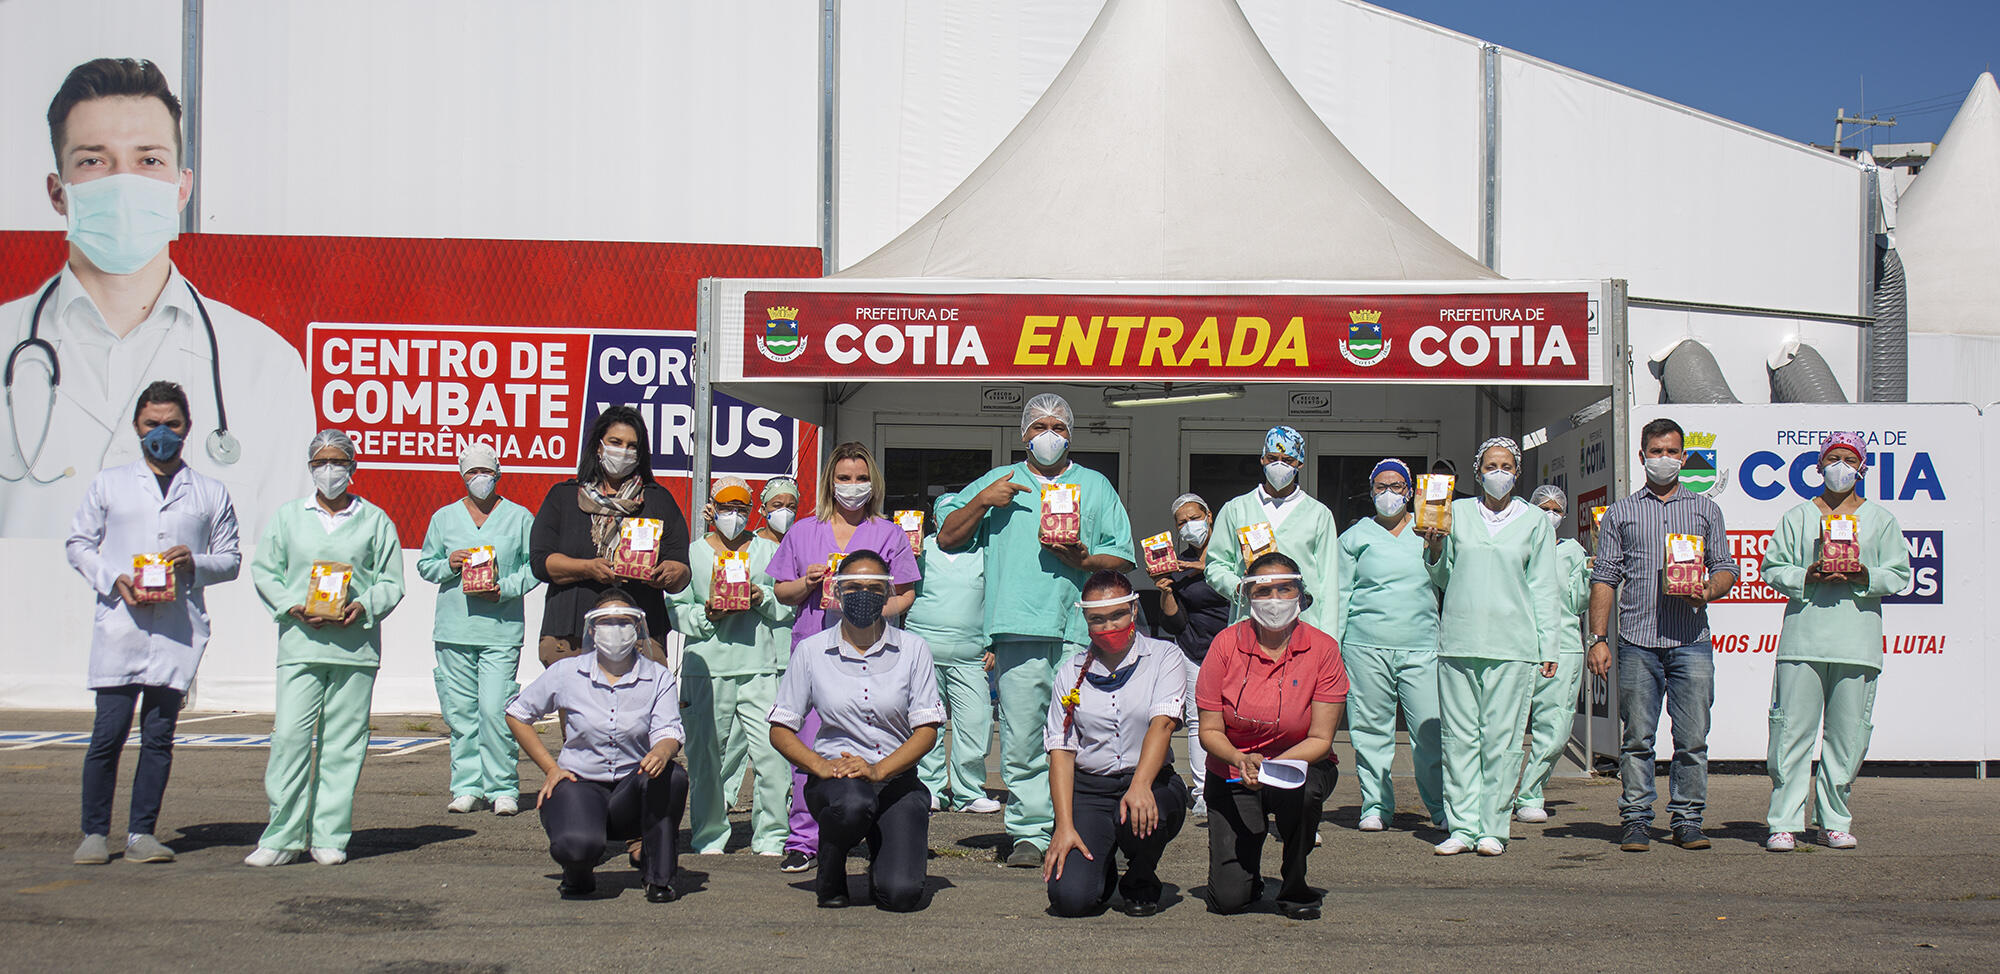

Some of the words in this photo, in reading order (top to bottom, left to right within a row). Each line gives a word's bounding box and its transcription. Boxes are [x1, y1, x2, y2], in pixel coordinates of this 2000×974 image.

[855, 308, 937, 321] PREFEITURA
[939, 308, 959, 321] DE
[1440, 308, 1522, 322] PREFEITURA
[1525, 308, 1545, 321] DE
[824, 323, 990, 365] COTIA
[1013, 315, 1310, 367] ENTRADA
[1408, 325, 1577, 367] COTIA
[322, 337, 498, 378] CENTRO
[510, 341, 567, 380] DE
[599, 347, 697, 386] COR
[322, 379, 570, 429] COMBATE
[528, 435, 566, 460] AO
[1777, 431, 1880, 445] PREFERA
[1884, 431, 1907, 445] DE
[1725, 534, 1773, 556] TRO
[1711, 634, 1750, 654] MOS
[1893, 635, 1946, 655] LUTA!
